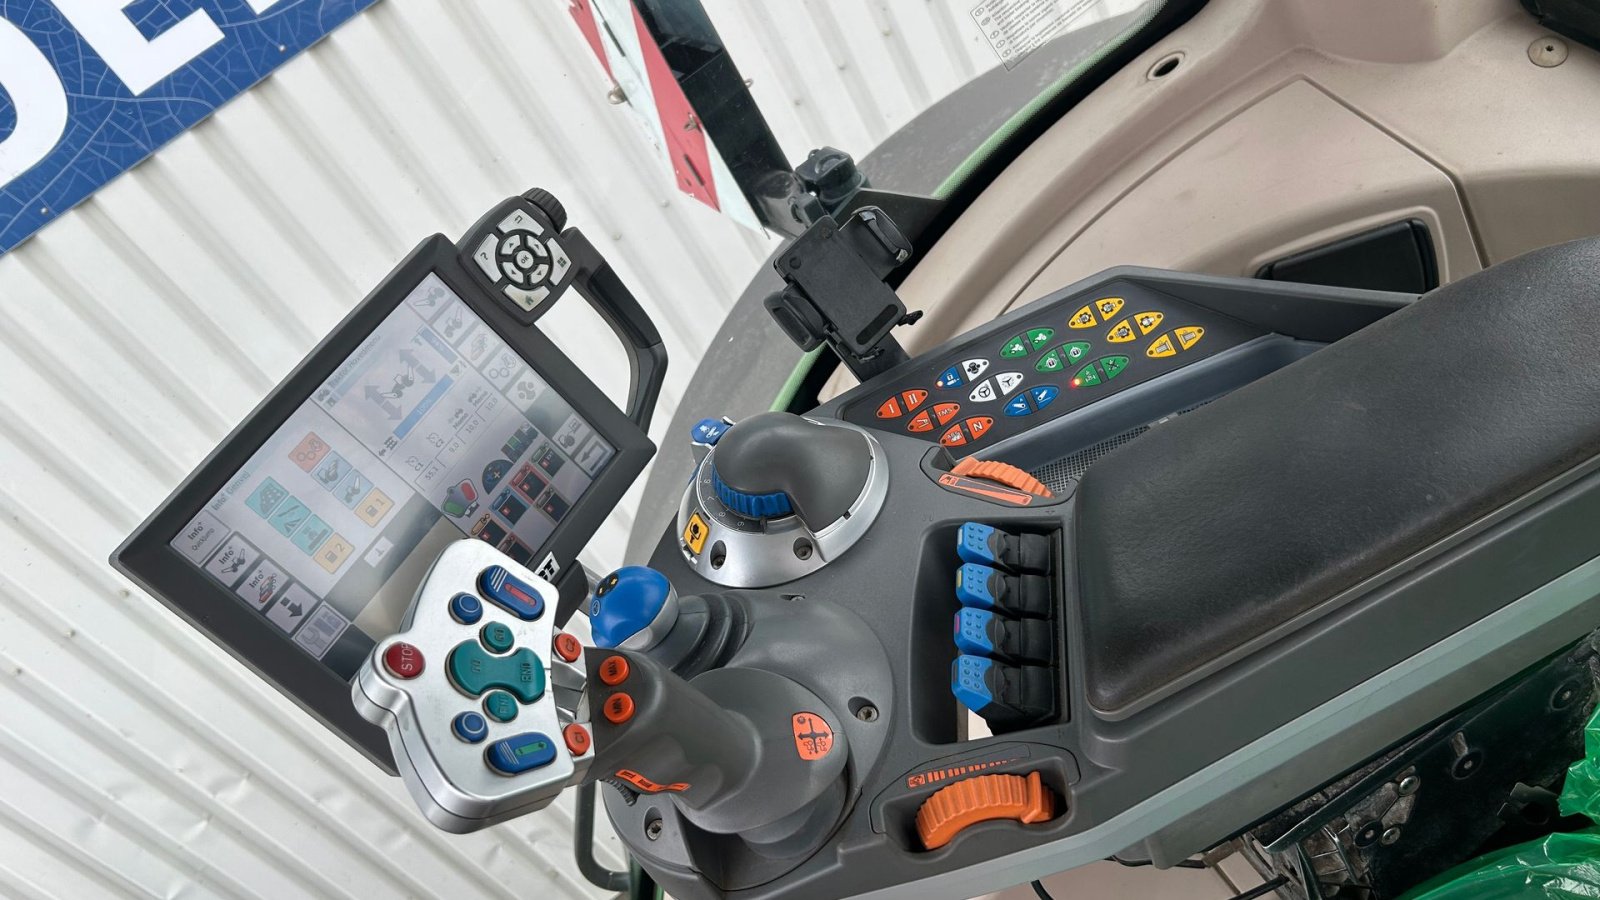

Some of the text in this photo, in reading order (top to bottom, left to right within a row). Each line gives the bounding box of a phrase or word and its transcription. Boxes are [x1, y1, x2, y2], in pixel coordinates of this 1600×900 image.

[520, 255, 529, 264] OK
[937, 408, 953, 417] TMS
[973, 421, 983, 432] N
[435, 438, 444, 448] C2
[414, 462, 423, 471] C1
[401, 643, 413, 671] STOP
